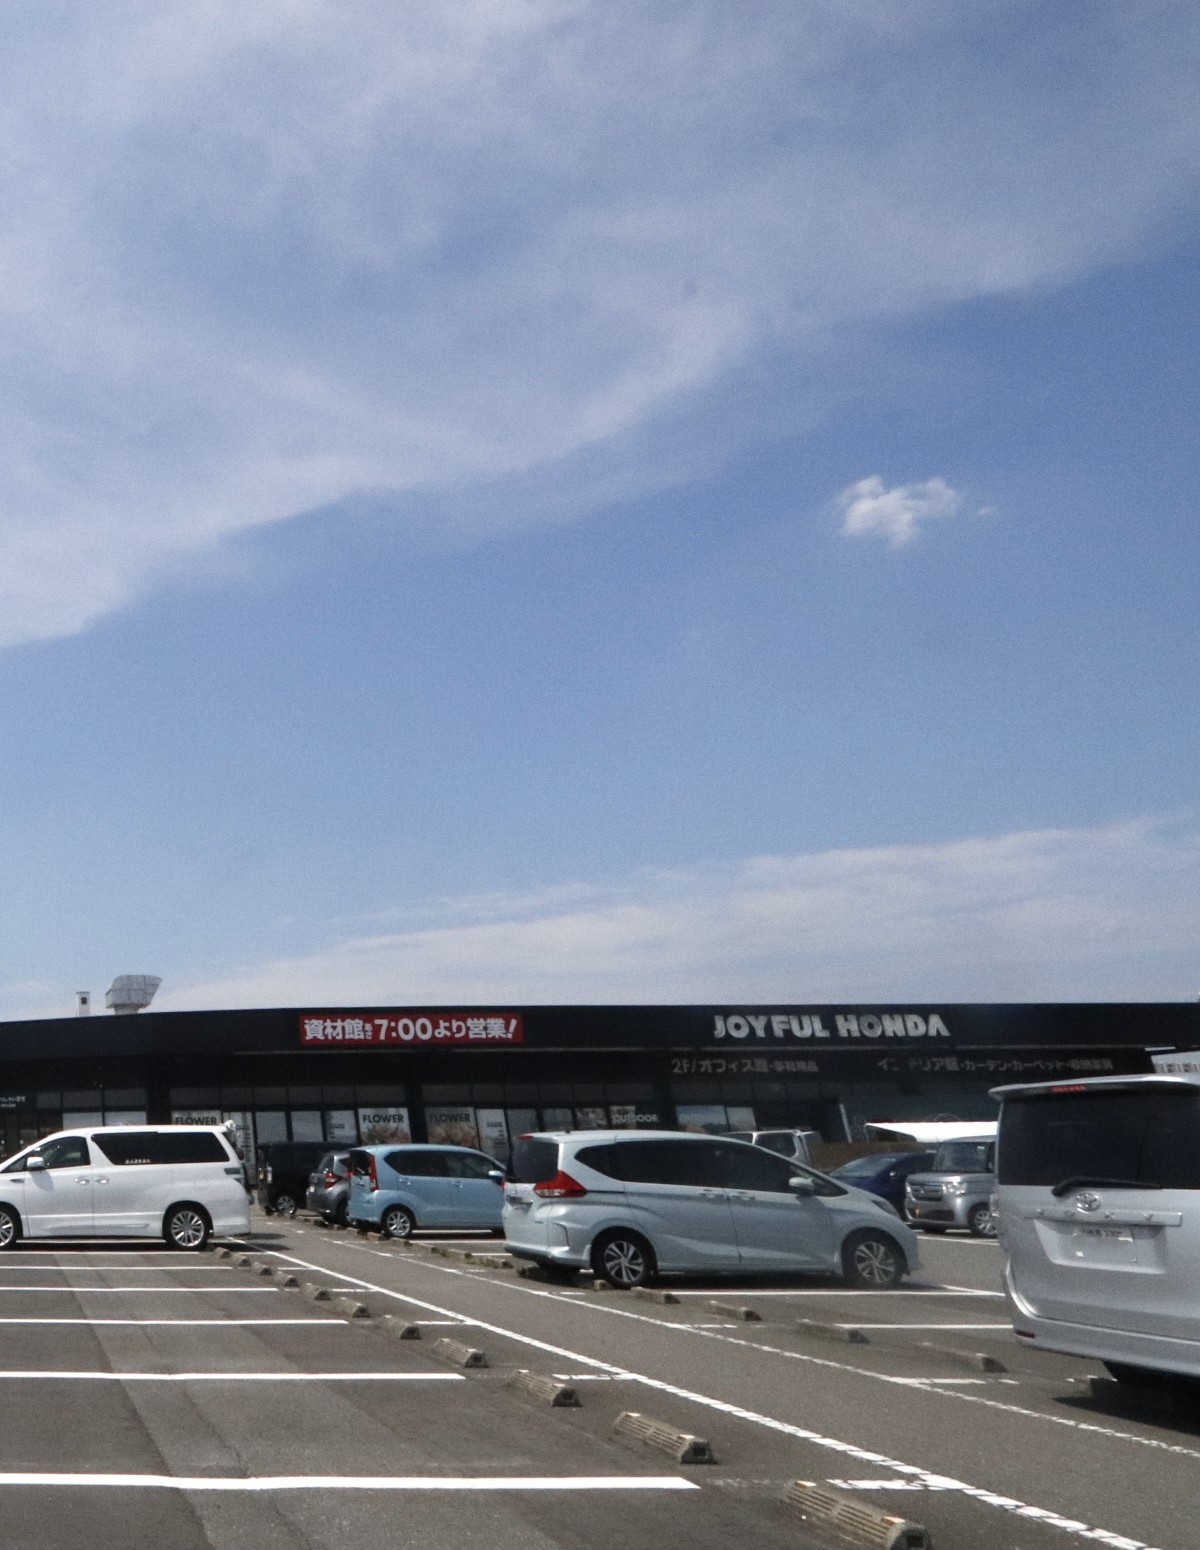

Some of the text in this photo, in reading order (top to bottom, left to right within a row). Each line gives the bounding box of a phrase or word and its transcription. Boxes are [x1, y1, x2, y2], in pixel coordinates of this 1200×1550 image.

[713, 1013, 951, 1039] JOYFUL HONDA
[175, 1116, 217, 1126] FLOWER
[362, 1113, 405, 1124] FLOWER
[428, 1112, 472, 1124] FLOWER
[612, 1113, 658, 1123] OUTDOOR
